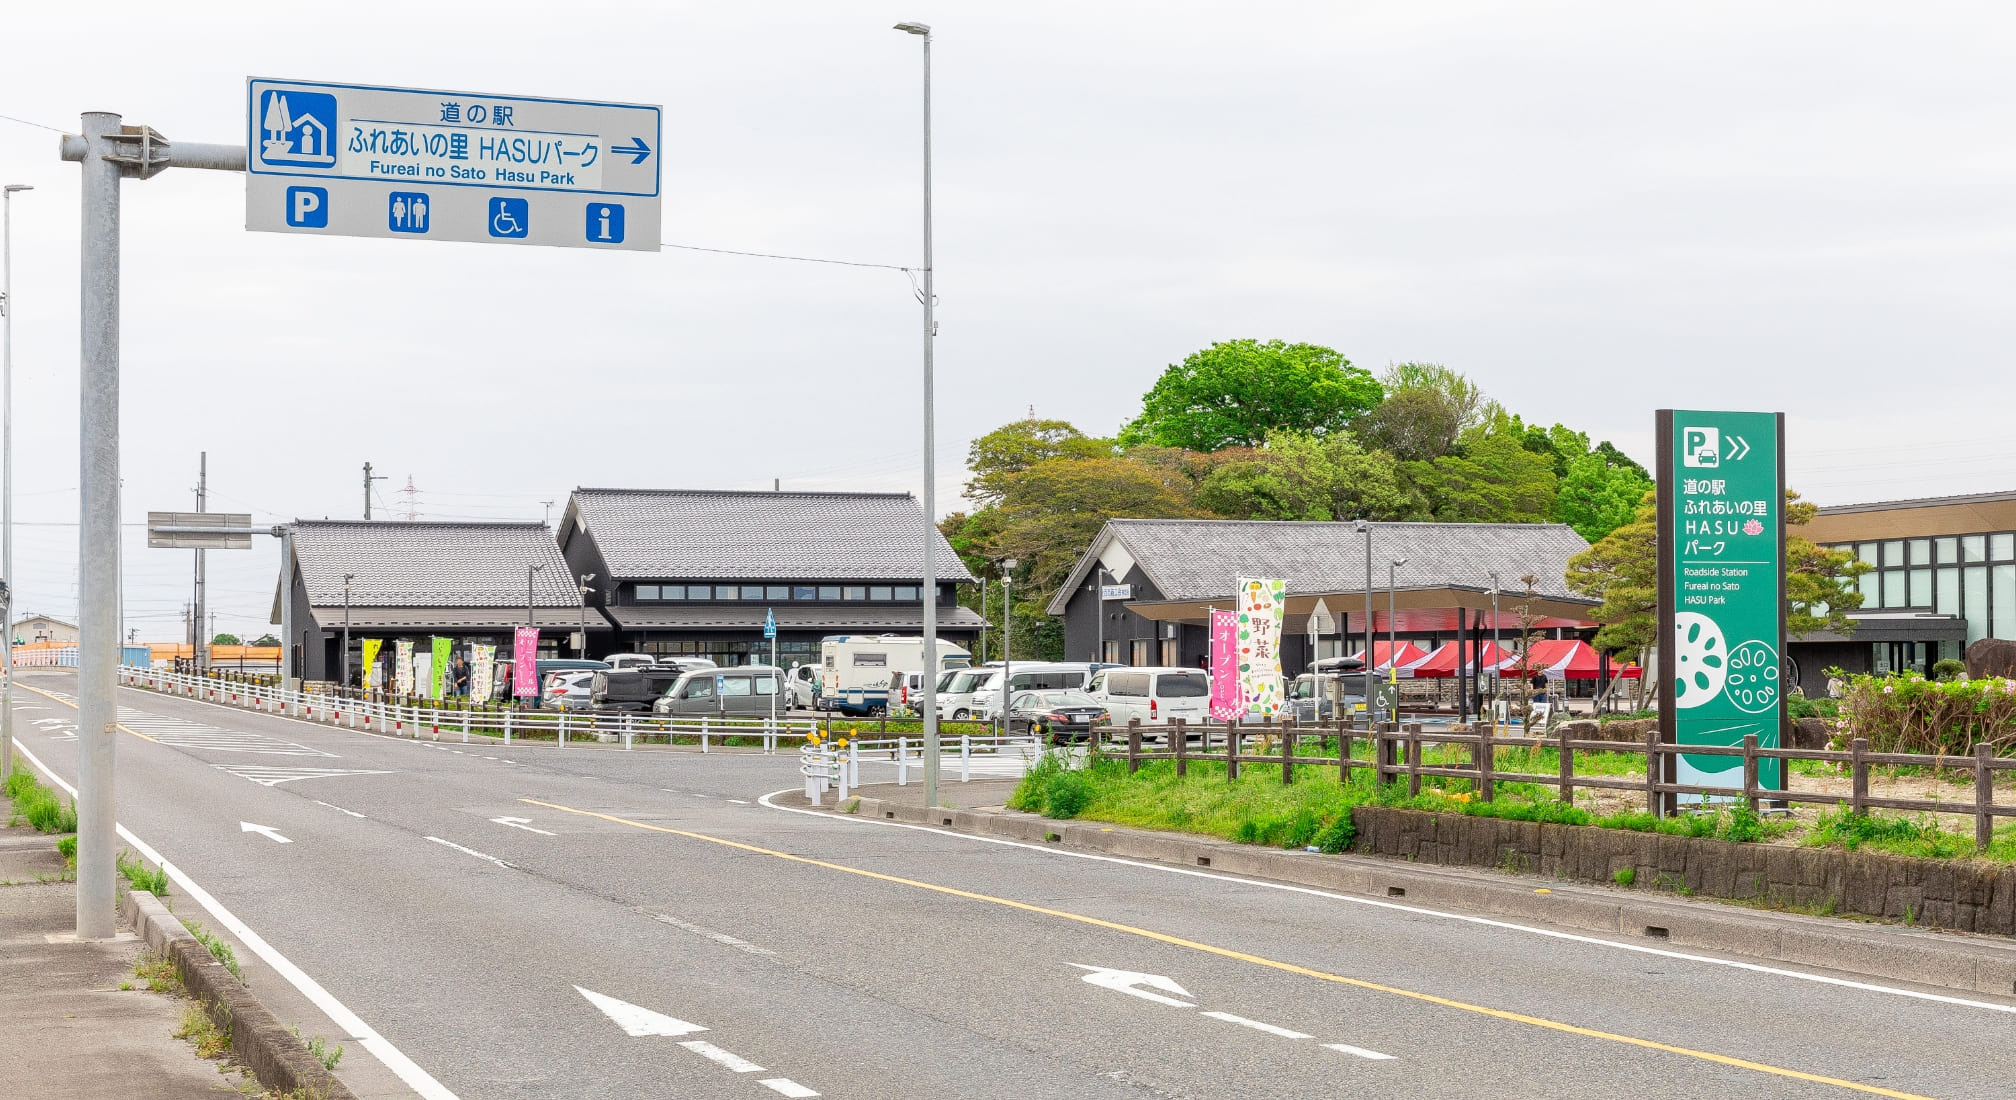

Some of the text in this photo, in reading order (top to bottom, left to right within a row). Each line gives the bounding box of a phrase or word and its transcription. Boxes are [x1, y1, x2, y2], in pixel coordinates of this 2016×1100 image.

[440, 101, 514, 127] 道の駅
[348, 126, 598, 168] ふれあいの里 HASUパーク
[370, 160, 575, 185] Fureai no Sato Hasu Park
[294, 191, 320, 222] P
[1687, 431, 1706, 456] P
[1683, 479, 1726, 495] 道の駅
[1684, 500, 1768, 516] ふれあいの里
[1686, 520, 1739, 535] HASU
[1684, 540, 1726, 555] パーク
[1684, 568, 1748, 577] Roadside Station
[1684, 582, 1709, 590] Fureai
[1722, 582, 1740, 590] Sato
[1684, 596, 1726, 605] HASU Park
[1252, 617, 1271, 659] 野菜
[527, 639, 535, 685] リニューアル
[1218, 630, 1232, 679] オープン
